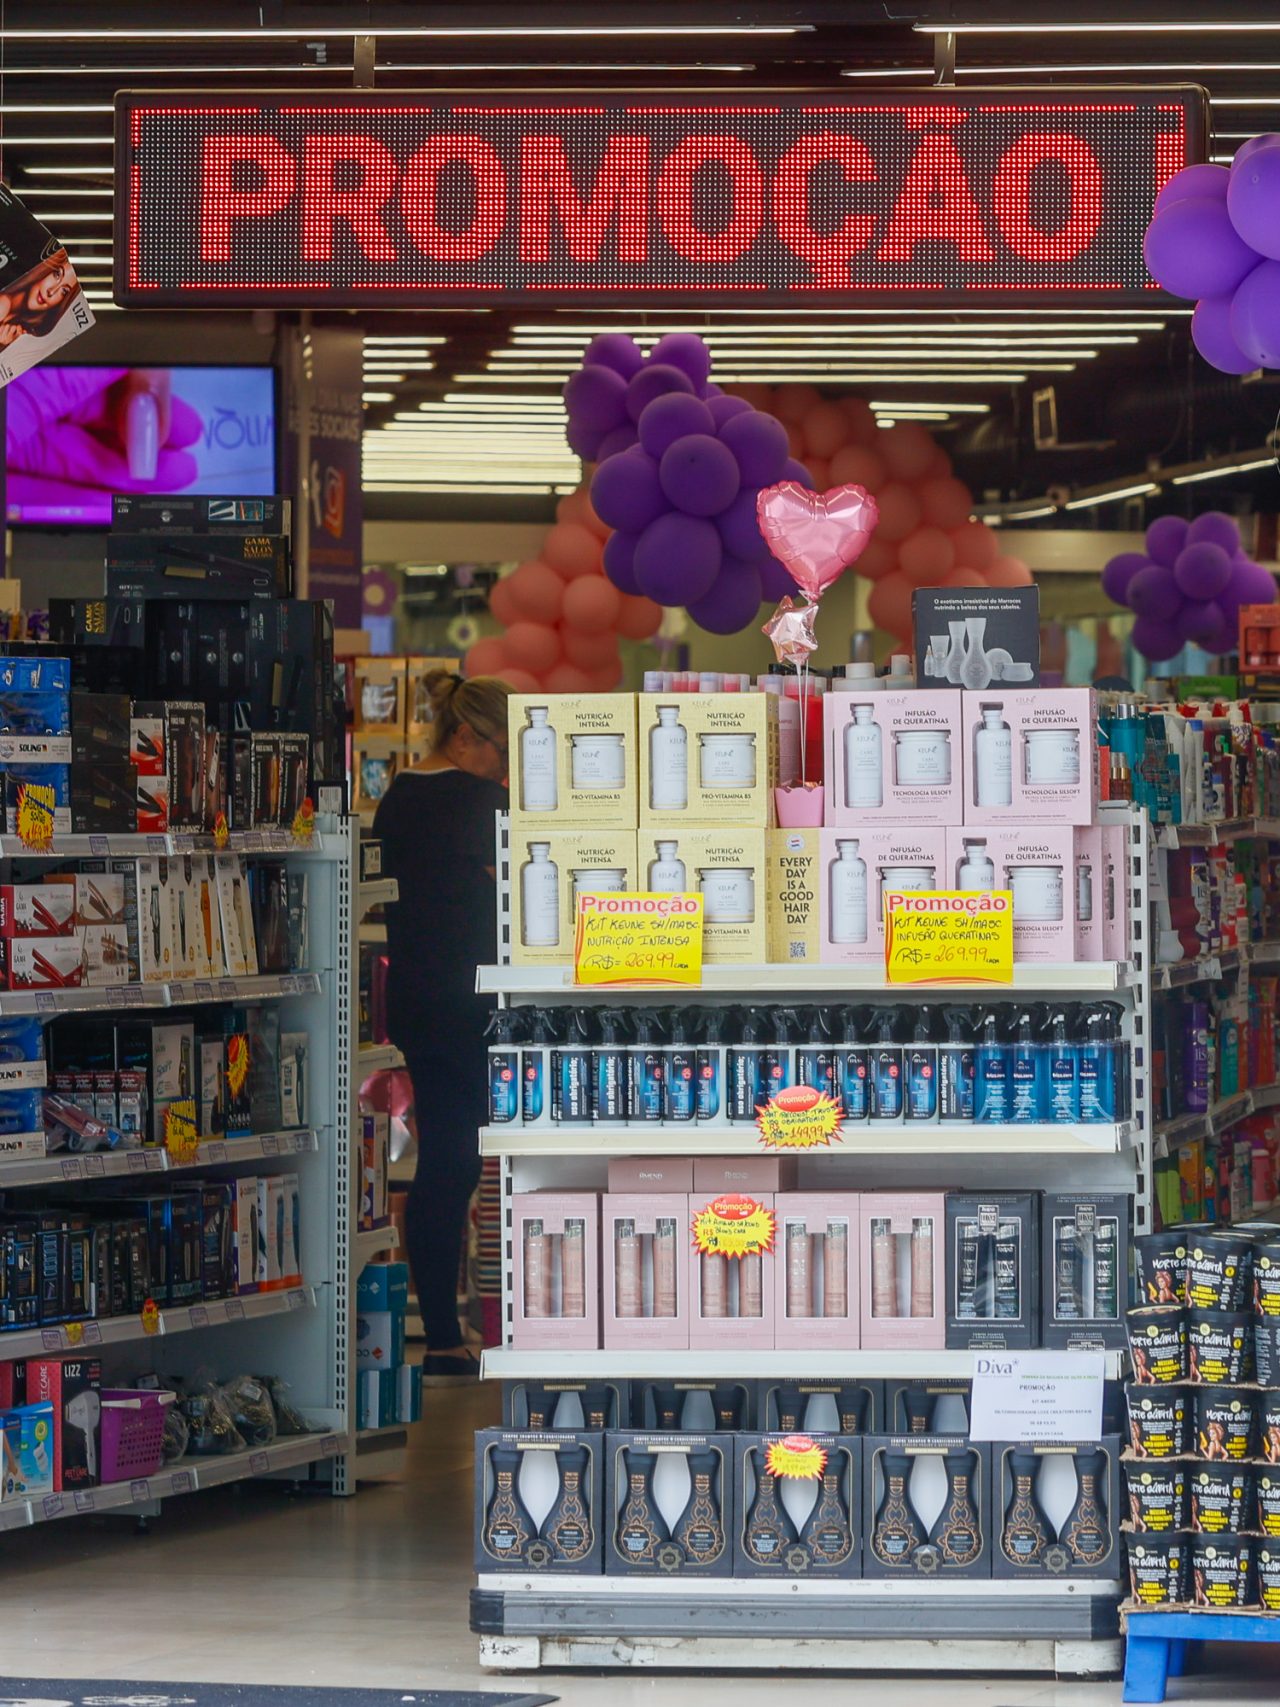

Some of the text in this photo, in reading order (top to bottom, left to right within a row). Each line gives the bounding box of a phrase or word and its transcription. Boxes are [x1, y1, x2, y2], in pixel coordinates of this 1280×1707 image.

[199, 106, 1101, 286] PROMOÇÃO
[245, 537, 271, 545] GAMA
[85, 603, 93, 632] GAMA
[575, 712, 613, 721] NUTRIÇÃO
[706, 712, 745, 720] NUTRIÇÃO
[903, 717, 949, 725] QUERATINAS
[1032, 716, 1078, 724] QUERATINAS
[576, 848, 615, 856] NUTRIÇÃO
[705, 847, 744, 855] NUTRIÇÃO
[779, 857, 813, 867] EVERY
[888, 853, 935, 861] QUERATINAS
[786, 869, 807, 878] DAY
[787, 880, 806, 890] IS A
[779, 891, 814, 901] GOOD
[581, 896, 698, 917] Promoção
[784, 903, 810, 912] HAIR
[889, 894, 1006, 915] Promoção
[585, 916, 608, 931] KIT
[609, 919, 646, 930] KEUNE
[787, 914, 808, 924] DAY
[894, 916, 915, 929] KIT
[914, 916, 949, 928] KEUNE
[896, 928, 1000, 941] INFUSÃO QUERATINAS
[587, 933, 690, 950] NUTRIÇÃO INTENSA
[778, 1093, 816, 1105] Promoção
[607, 1100, 615, 1115] uso
[737, 1100, 745, 1115] uso
[789, 1125, 824, 1139] 149,99
[714, 1203, 753, 1211] Promoção
[1152, 1258, 1180, 1270] MORTE
[64, 1364, 81, 1378] LIZZ
[977, 1359, 1013, 1374] Diva
[1019, 1384, 1056, 1392] PROMOÇÃO
[1206, 1409, 1234, 1422] MORTE
